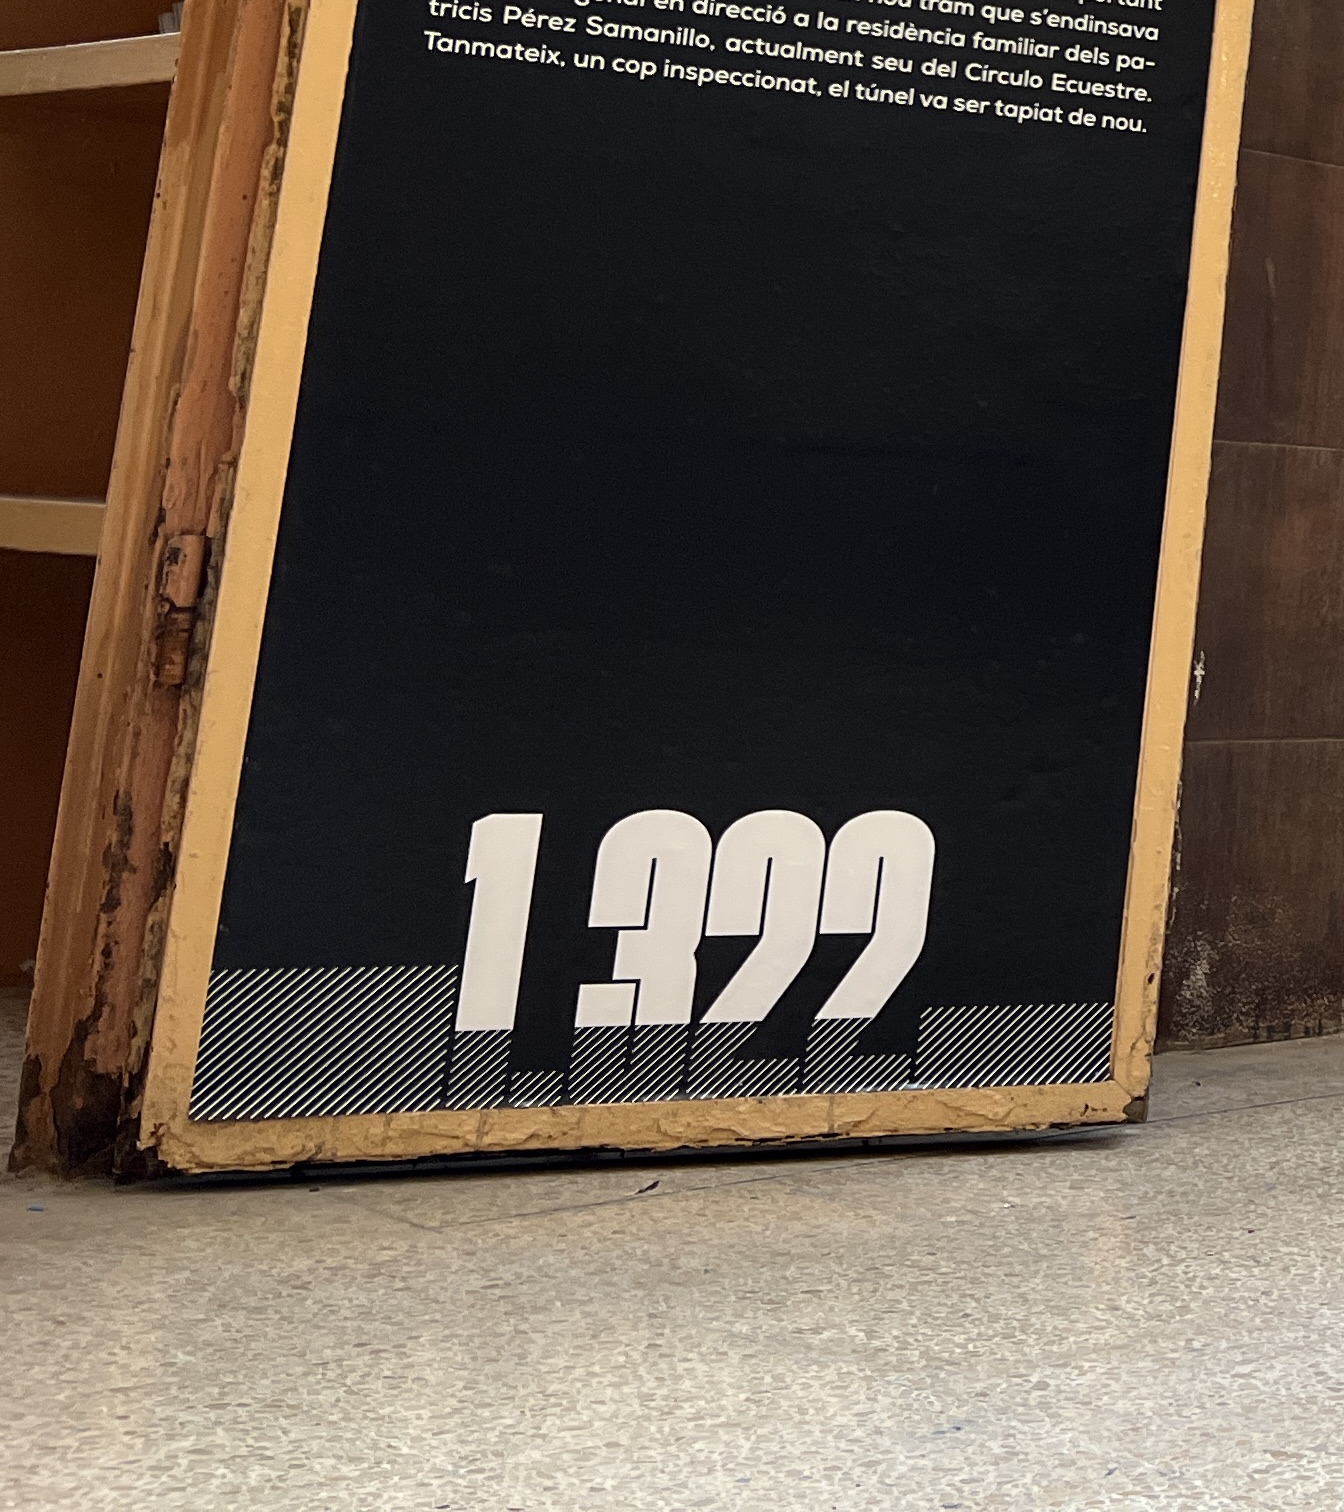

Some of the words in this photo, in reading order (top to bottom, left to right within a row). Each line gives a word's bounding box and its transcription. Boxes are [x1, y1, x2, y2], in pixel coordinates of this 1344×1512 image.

[424, 30, 565, 67] Tanmateix,
[573, 53, 605, 69] un
[612, 58, 657, 80] cop
[663, 59, 821, 97] inspeccionat,
[828, 80, 849, 98] el
[855, 83, 915, 105] túnel
[919, 94, 948, 109] va
[953, 97, 990, 113] ser
[994, 100, 1063, 123] tapiat
[1068, 108, 1096, 126] de
[1101, 115, 1146, 132] nou.
